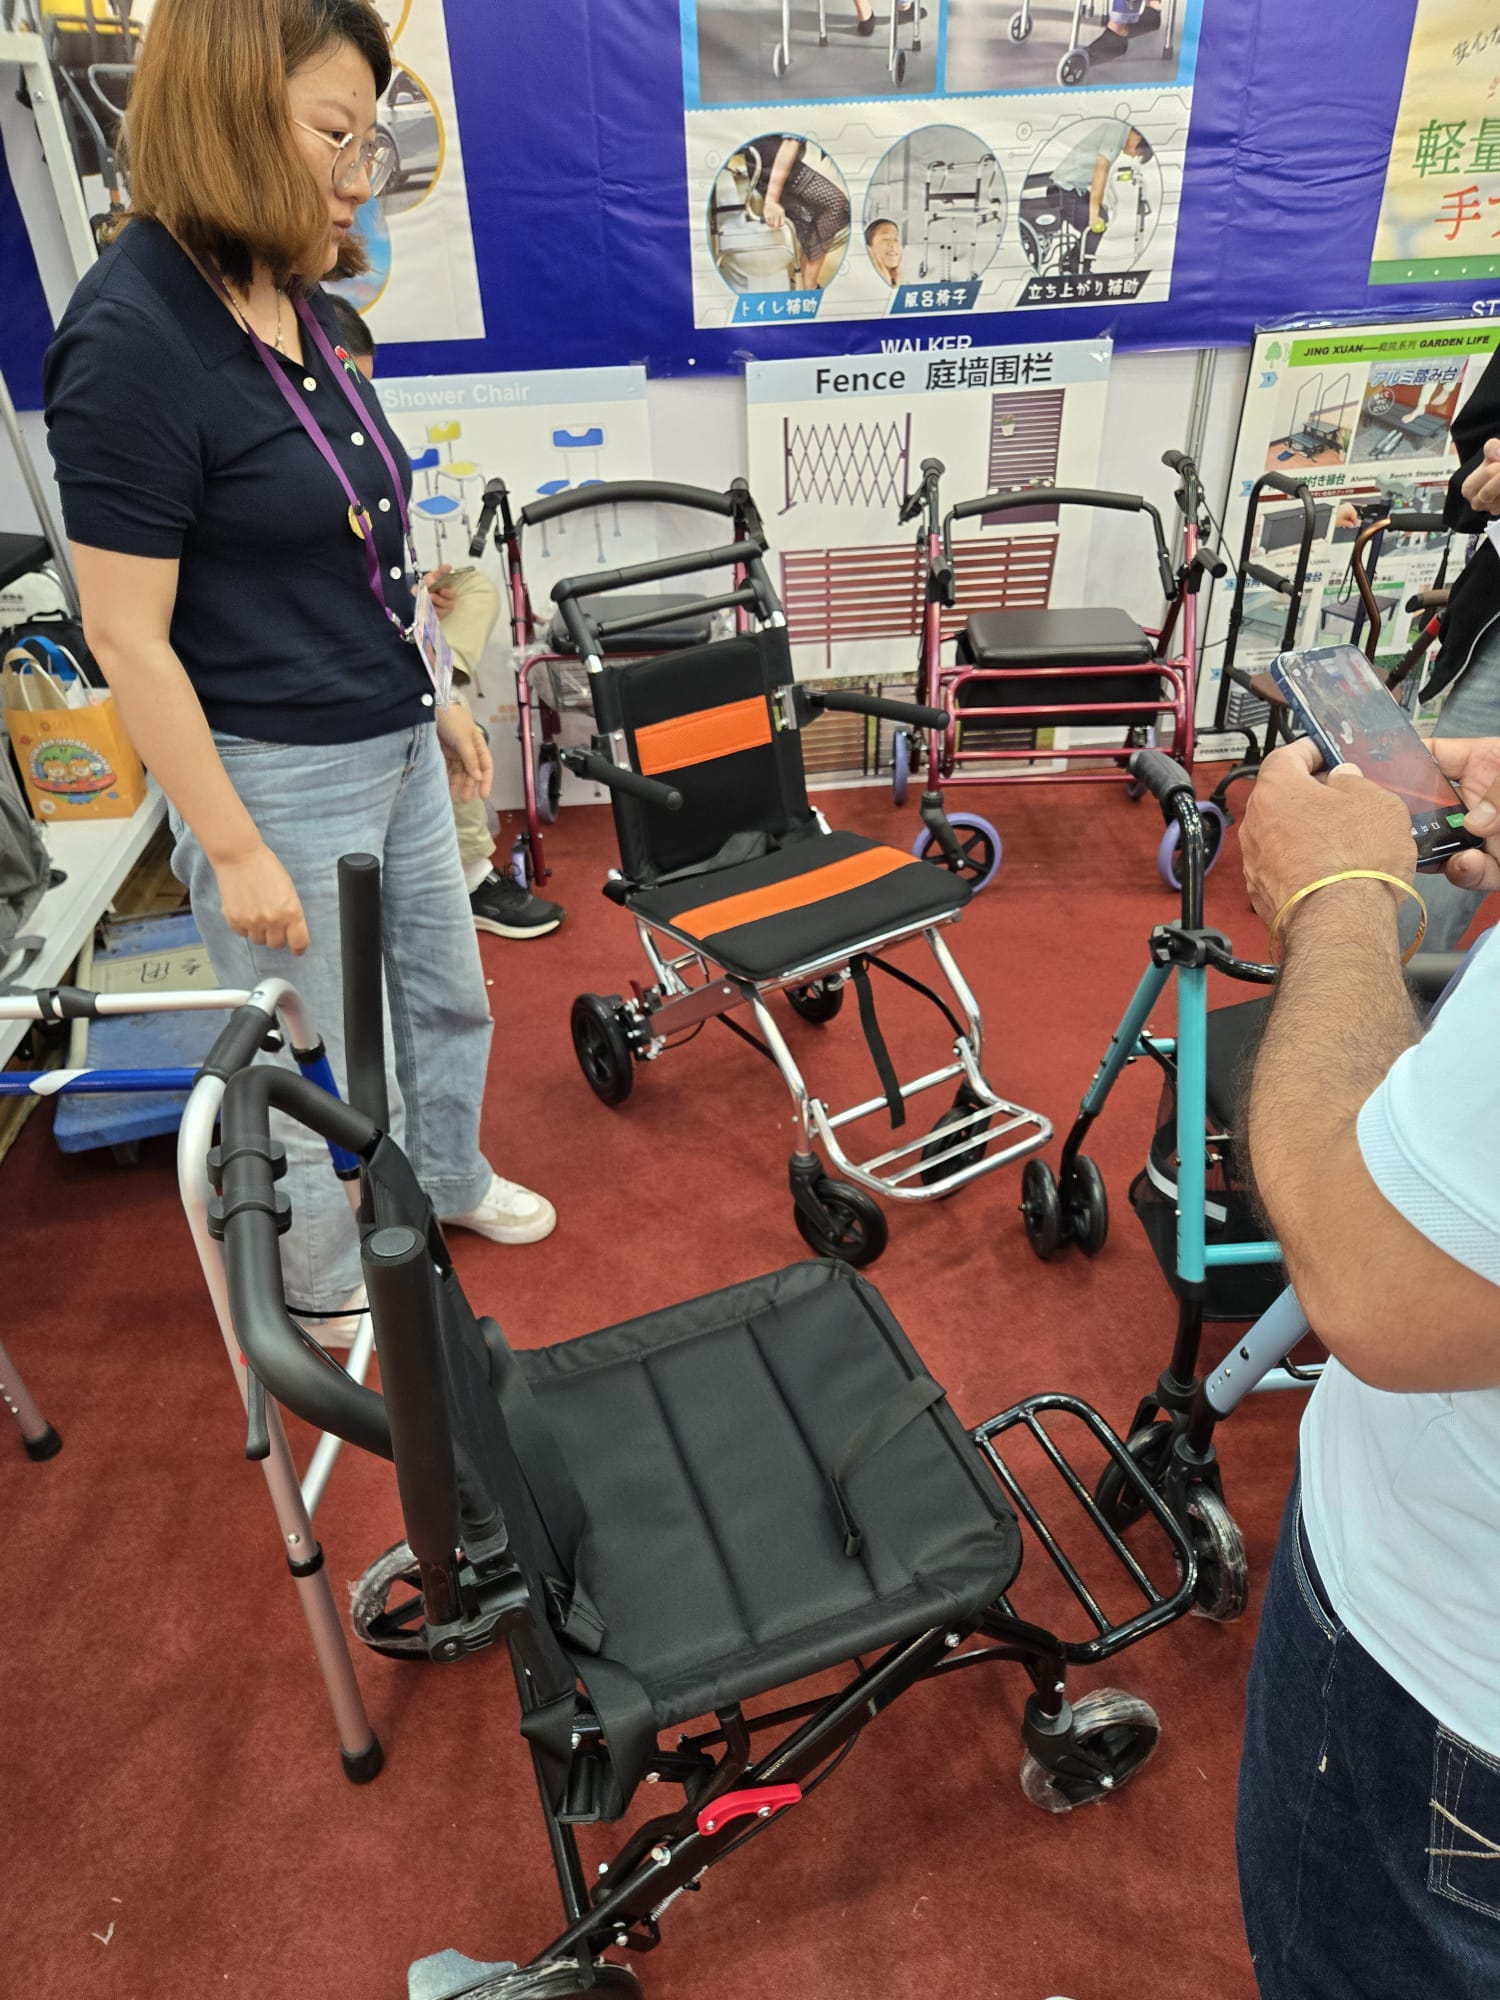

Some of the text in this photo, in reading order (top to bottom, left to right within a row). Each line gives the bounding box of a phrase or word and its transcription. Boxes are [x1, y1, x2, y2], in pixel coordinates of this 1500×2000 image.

[1434, 185, 1500, 241] 手
[904, 288, 967, 308] 風呂椅子
[1028, 278, 1139, 300] 立ち上がり補助
[741, 297, 817, 316] トイレ補助
[1304, 347, 1329, 356] JING
[1419, 337, 1463, 348] GARDEN
[1466, 335, 1490, 345] LIFE
[816, 352, 1053, 394] Fence 庭墙围栏
[383, 383, 529, 408] Shower Chair
